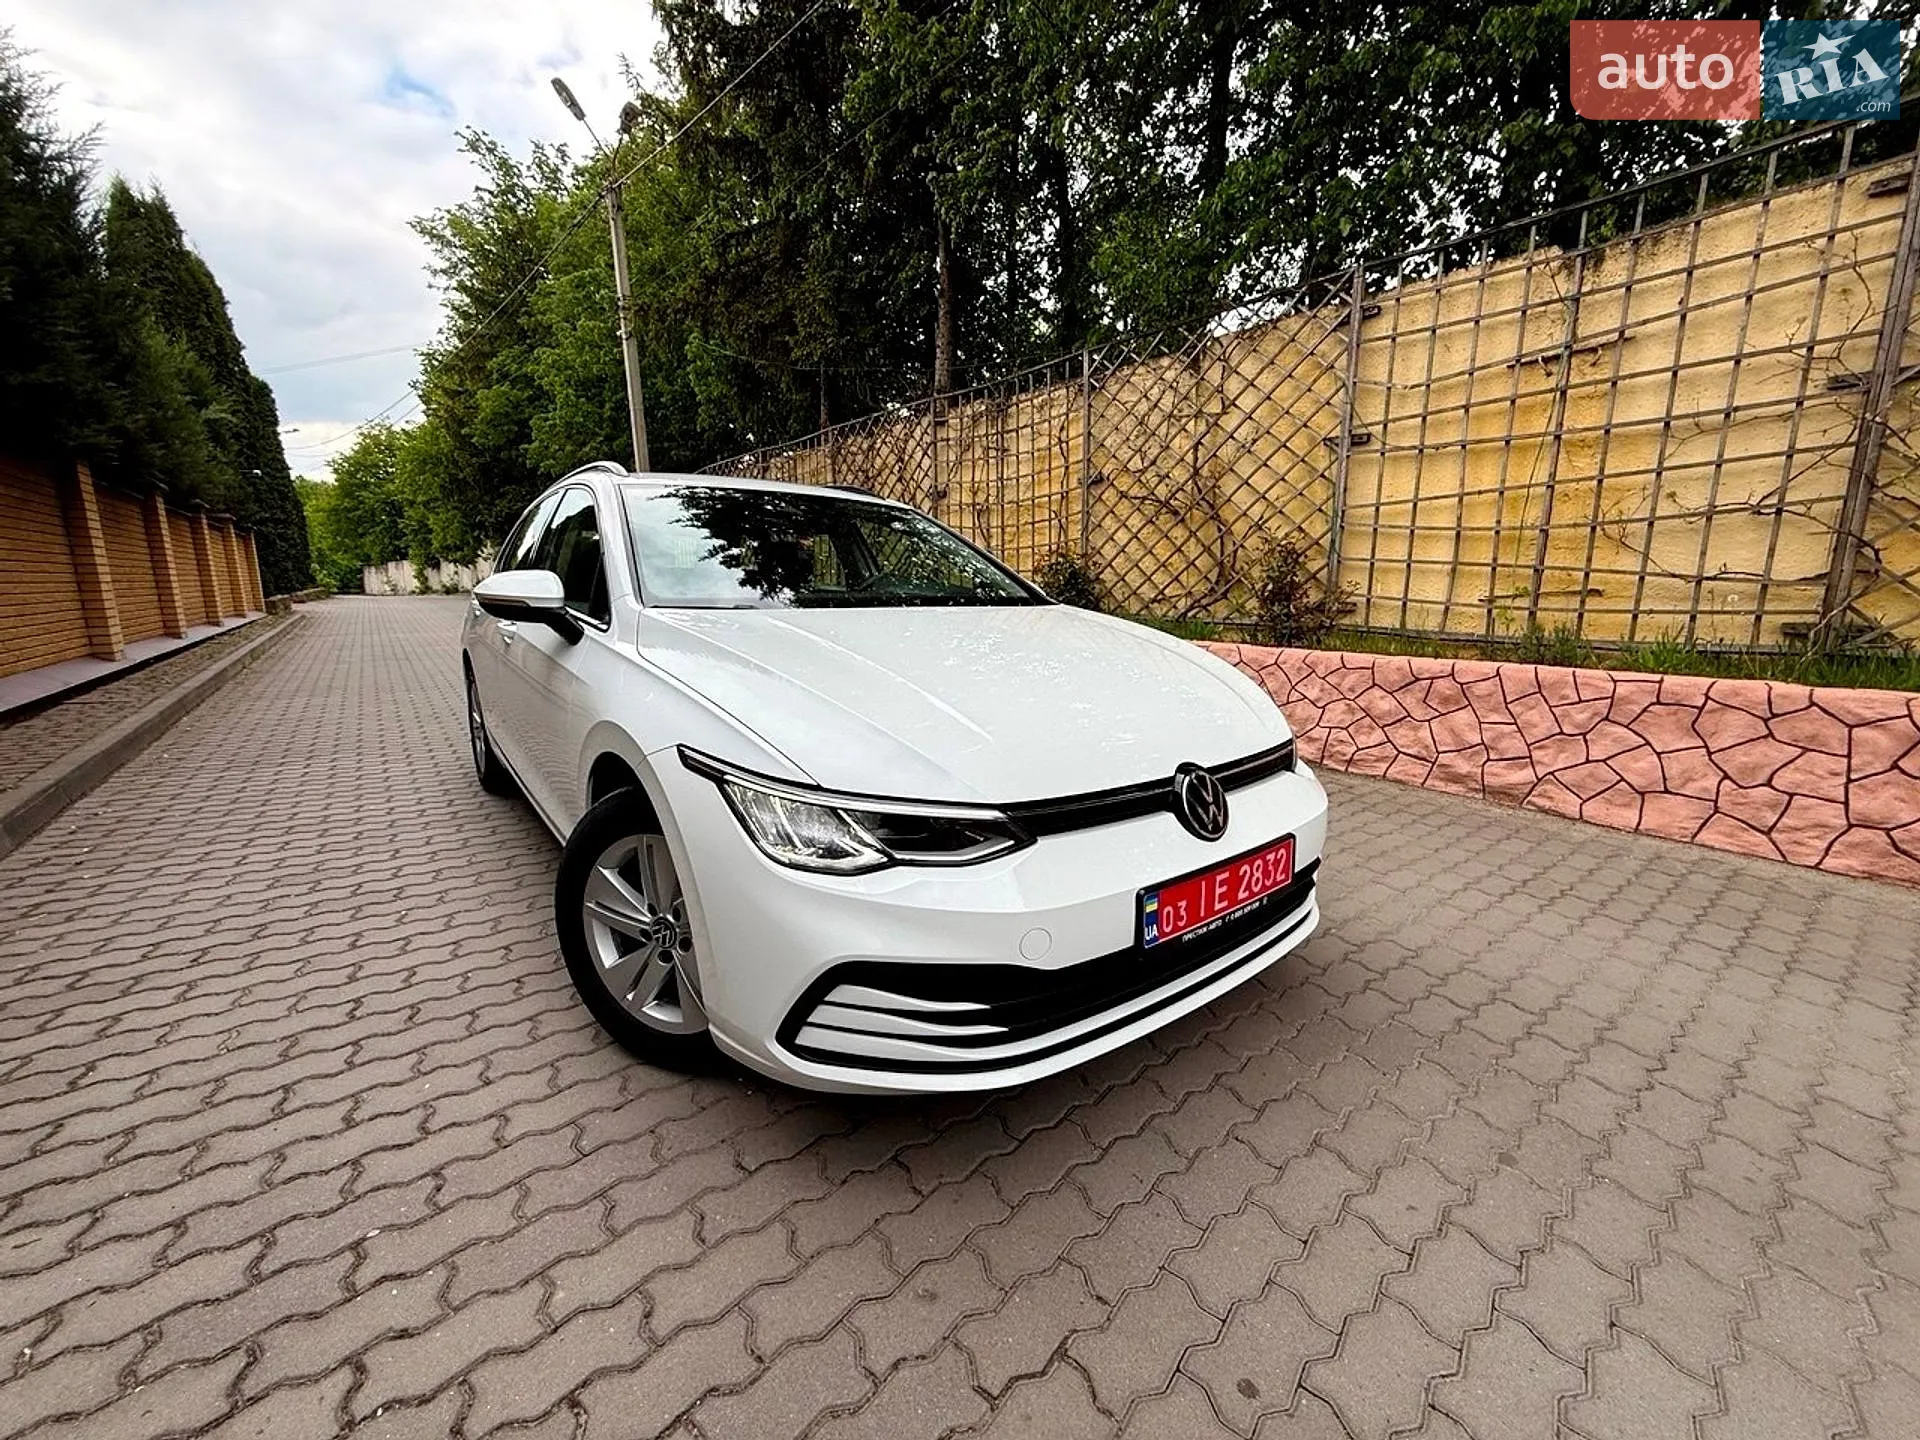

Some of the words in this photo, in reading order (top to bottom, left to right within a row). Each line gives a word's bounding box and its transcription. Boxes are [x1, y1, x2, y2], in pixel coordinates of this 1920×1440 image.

[1162, 900, 1187, 933] 03
[1200, 872, 1230, 918] IE
[1238, 848, 1287, 900] 2832
[1144, 924, 1159, 940] UA
